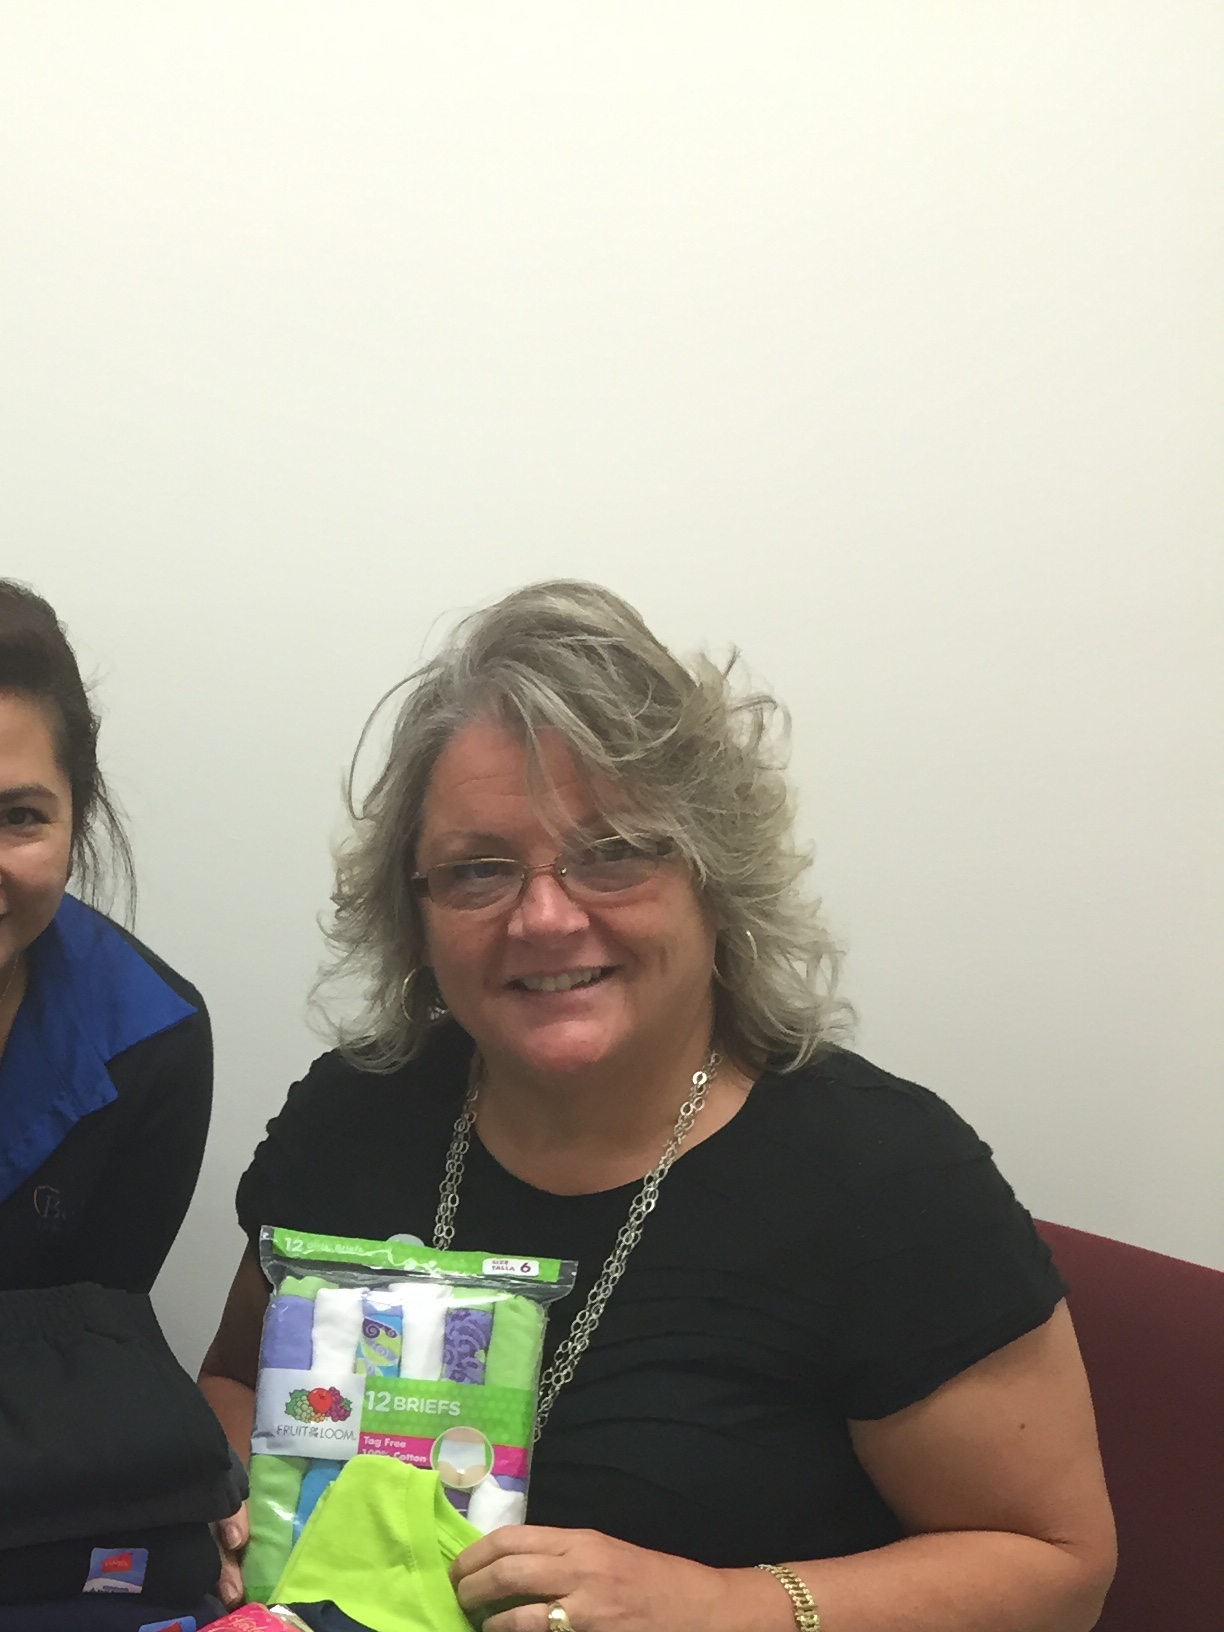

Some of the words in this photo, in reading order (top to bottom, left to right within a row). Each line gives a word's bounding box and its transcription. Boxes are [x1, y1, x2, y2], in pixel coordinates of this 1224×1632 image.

[285, 1237, 304, 1253] 12
[519, 1262, 532, 1274] 6
[364, 1390, 390, 1412] 12
[393, 1396, 461, 1416] BRIEFS
[276, 1424, 309, 1438] FRUIT
[319, 1428, 355, 1441] LOOM
[363, 1436, 383, 1448] Tag
[384, 1438, 407, 1448] Free
[393, 1450, 427, 1463] Cotton
